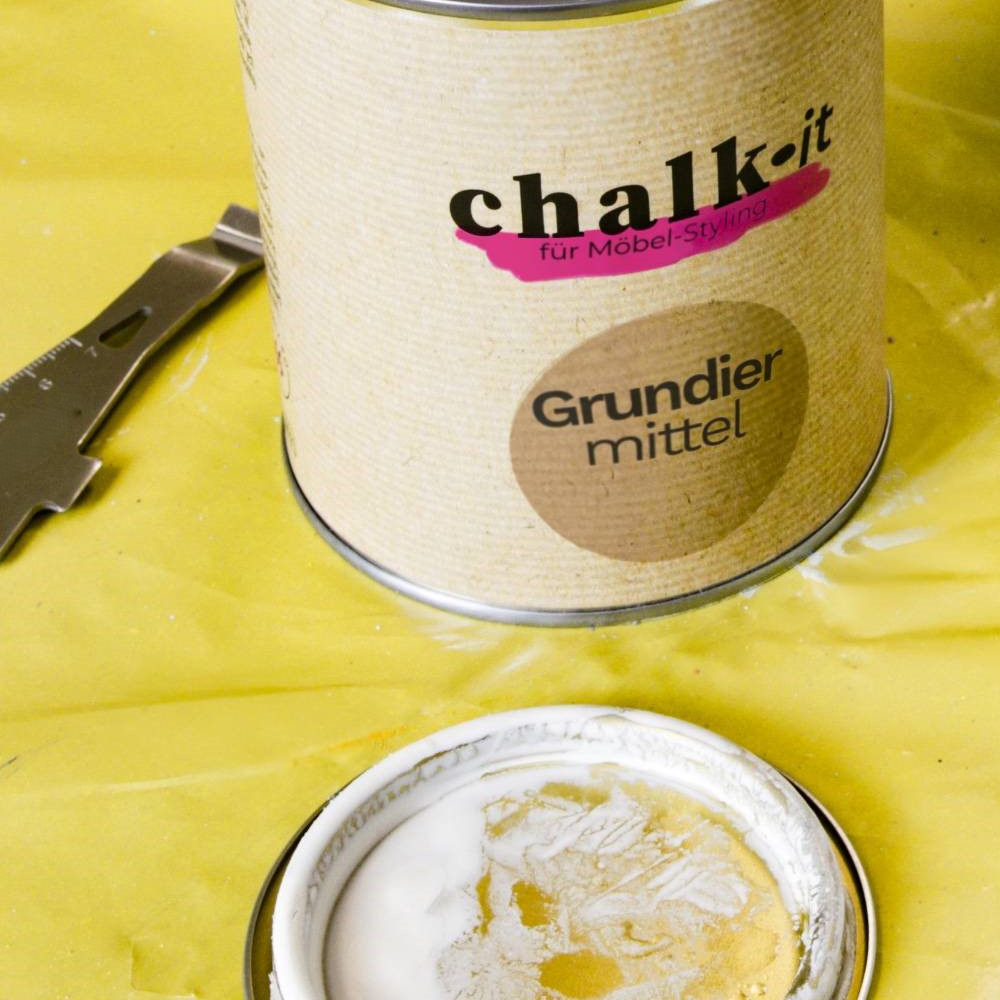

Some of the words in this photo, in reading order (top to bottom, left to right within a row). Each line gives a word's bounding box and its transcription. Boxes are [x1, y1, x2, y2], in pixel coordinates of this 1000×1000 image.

[540, 242, 580, 261] für
[588, 198, 768, 259] Möbel-Styling
[532, 348, 784, 429] Grundier
[586, 398, 748, 466] mittel
